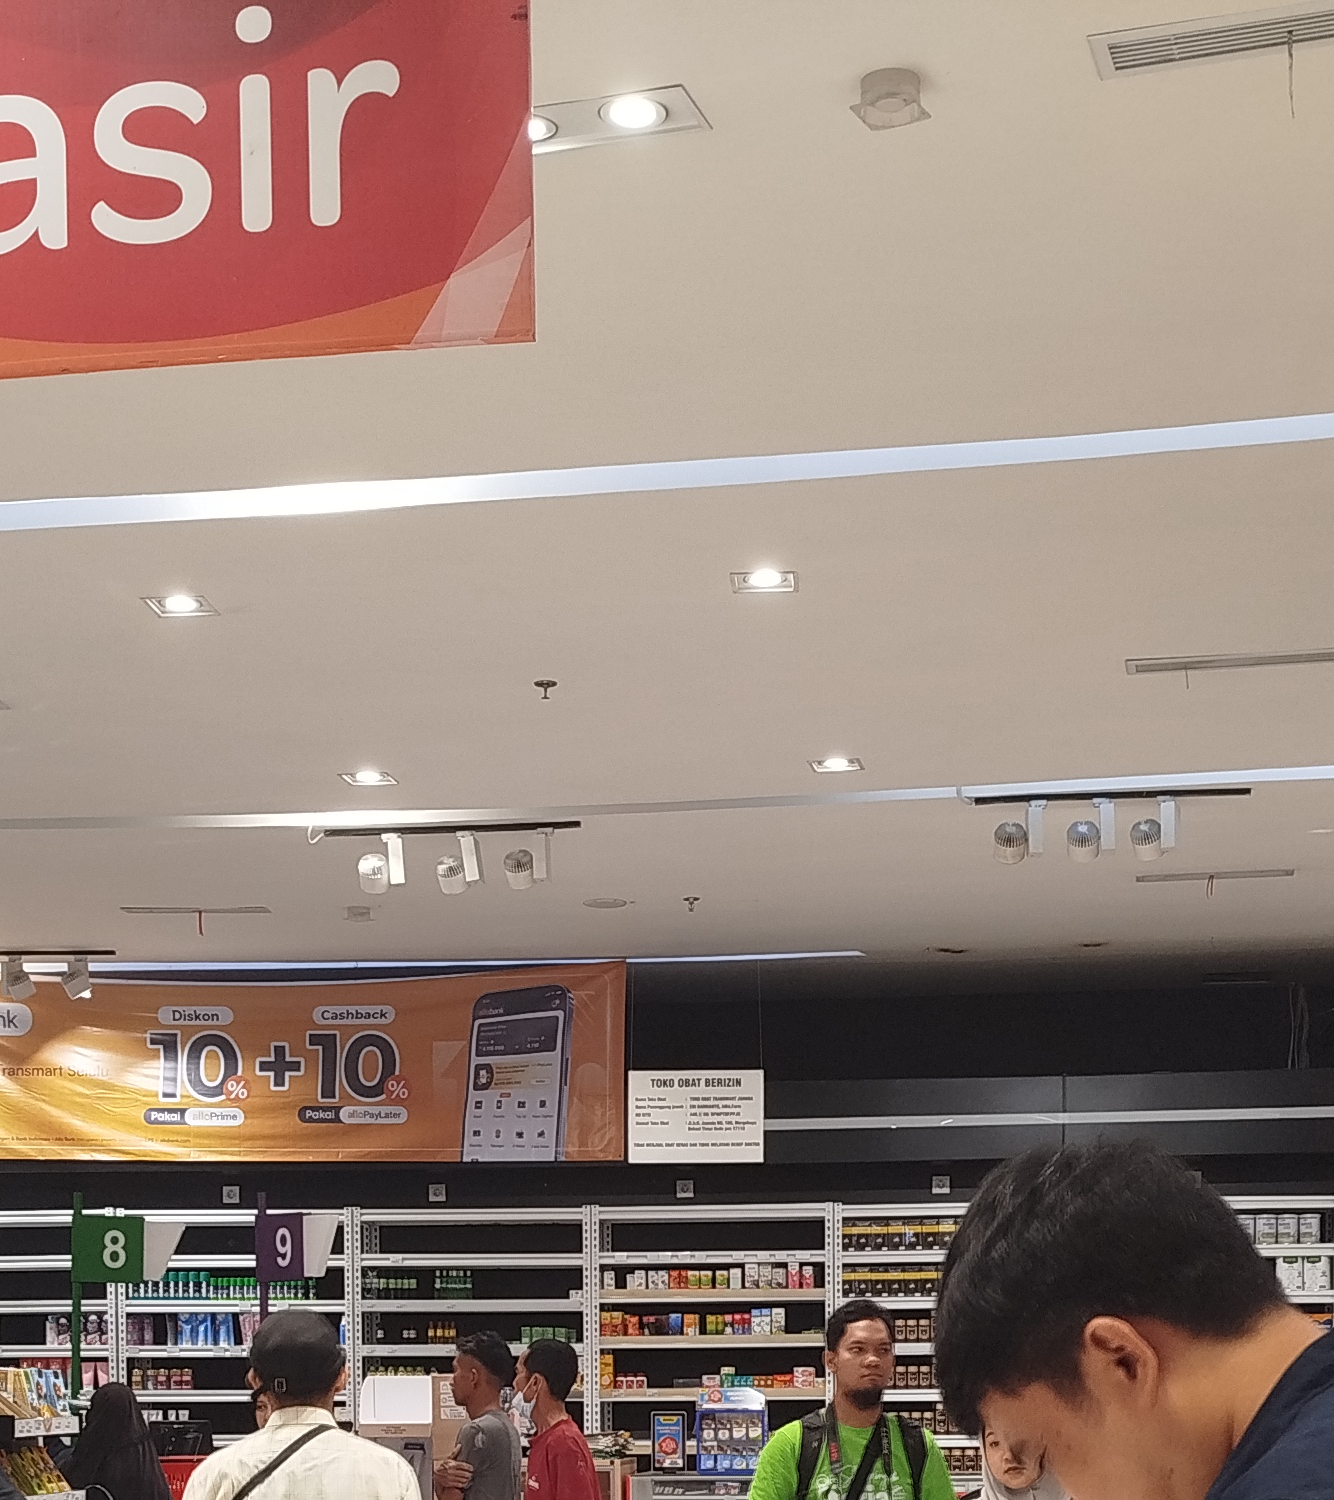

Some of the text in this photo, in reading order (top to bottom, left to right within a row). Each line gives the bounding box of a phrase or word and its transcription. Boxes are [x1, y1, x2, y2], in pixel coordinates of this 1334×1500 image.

[172, 1010, 220, 1022] Diskon
[321, 1009, 388, 1021] Cashback
[650, 1078, 741, 1088] TOKO OBAT BERIZIN
[151, 1112, 180, 1122] Pakai
[305, 1110, 335, 1120] Pakai
[102, 1230, 126, 1269] 8
[275, 1227, 292, 1267] 9
